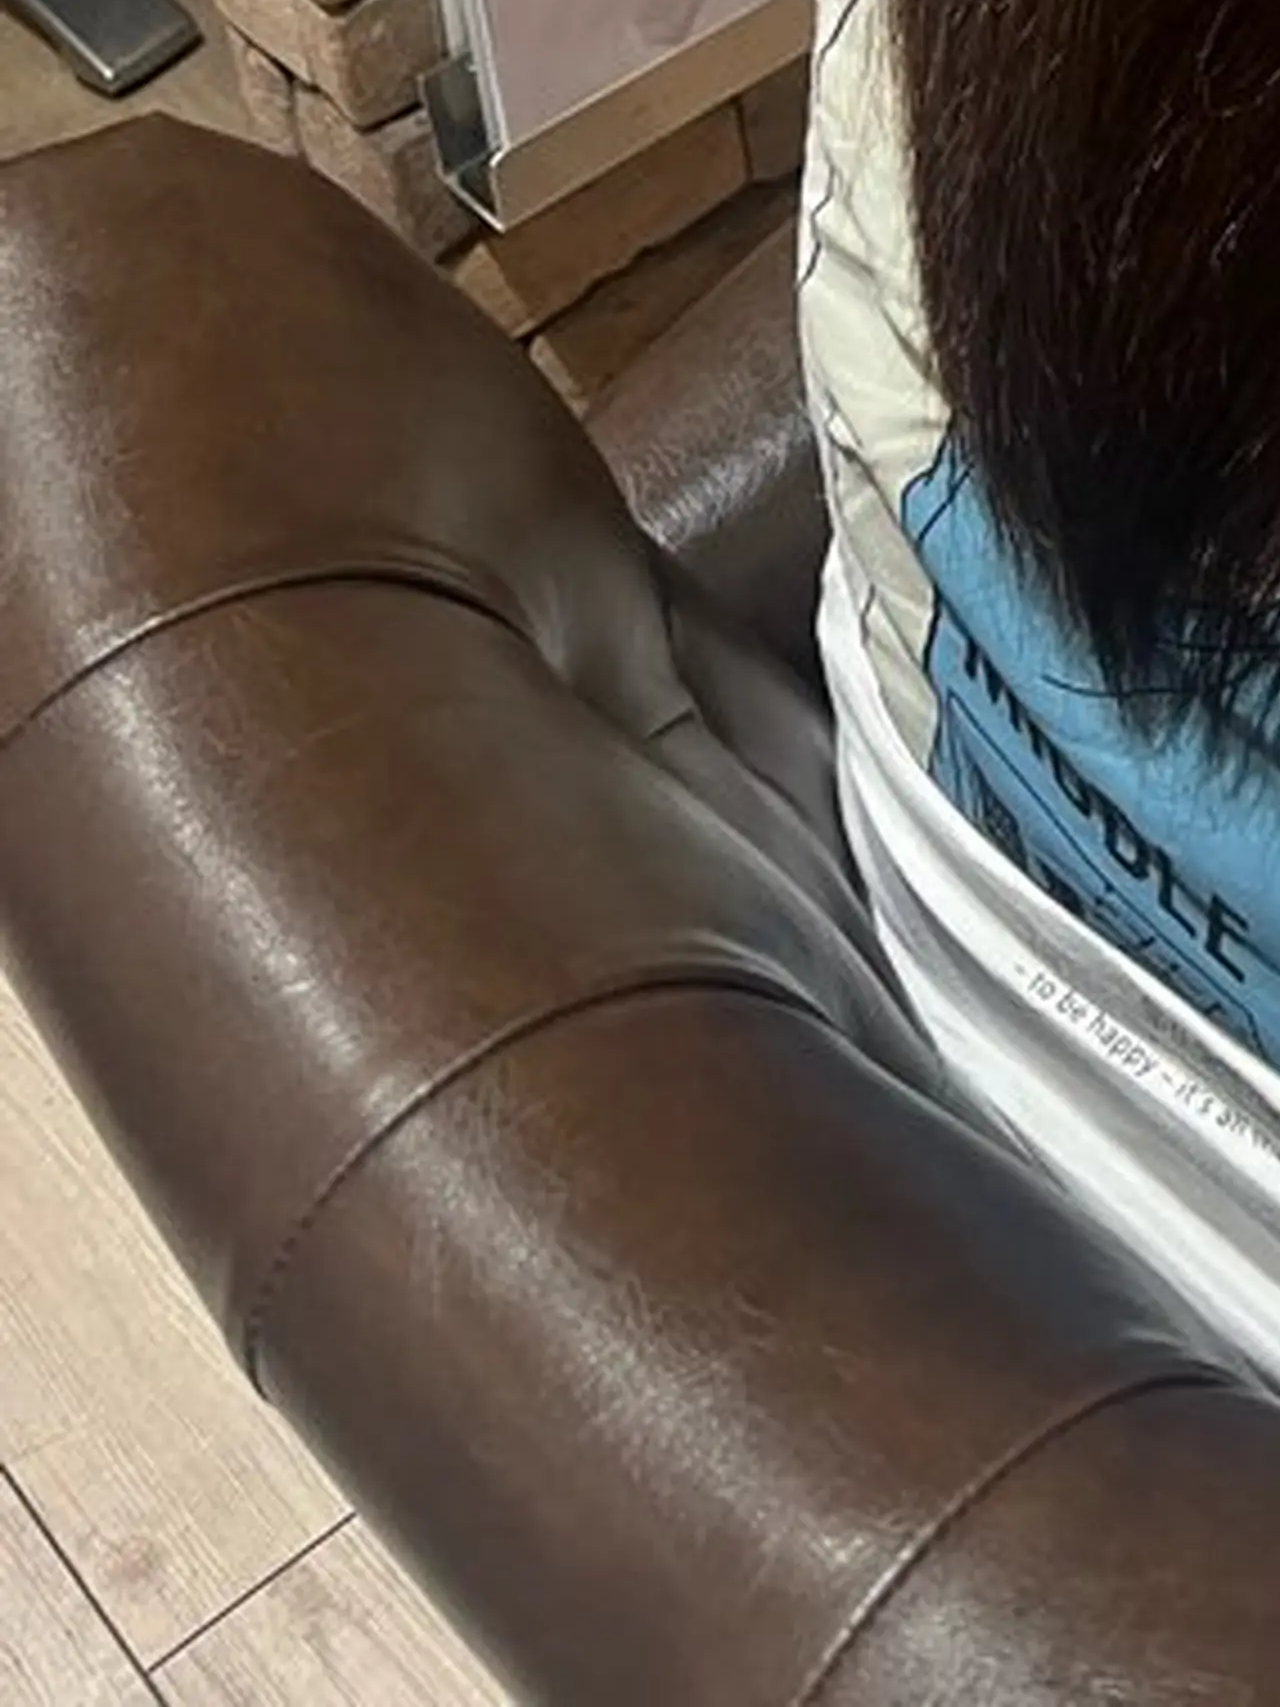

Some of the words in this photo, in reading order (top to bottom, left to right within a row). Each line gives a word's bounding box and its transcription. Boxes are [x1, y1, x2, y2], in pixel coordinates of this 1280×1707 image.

[1027, 971, 1056, 1000] to
[1056, 988, 1087, 1024] be
[1087, 1011, 1160, 1078] happy
